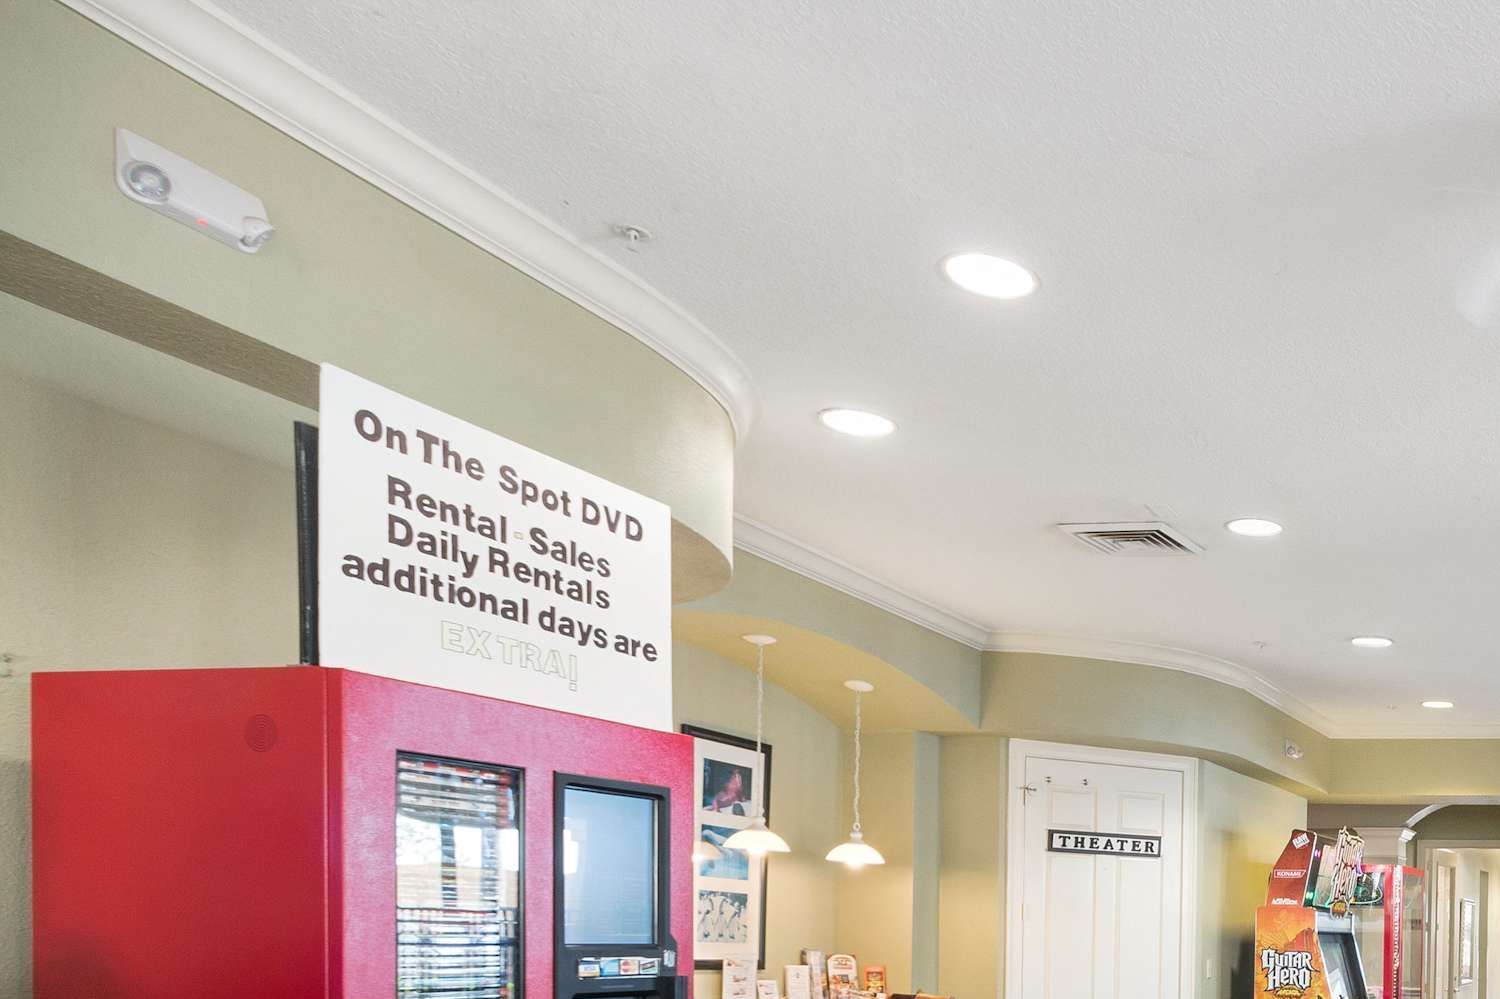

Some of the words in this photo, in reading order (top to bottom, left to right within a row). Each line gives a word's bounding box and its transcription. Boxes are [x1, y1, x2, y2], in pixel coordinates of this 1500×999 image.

[354, 408, 408, 455] On
[415, 428, 486, 482] The
[498, 464, 573, 519] Spot
[581, 497, 644, 543] DVD
[386, 475, 508, 544] Rental
[529, 527, 612, 578] Sales
[387, 513, 480, 579] Daily
[488, 546, 611, 610] Rentals
[341, 553, 529, 625] additional
[538, 605, 608, 649] days
[613, 634, 659, 663] are
[441, 620, 579, 691] EXTRA!
[1058, 835, 1155, 853] THEATER
